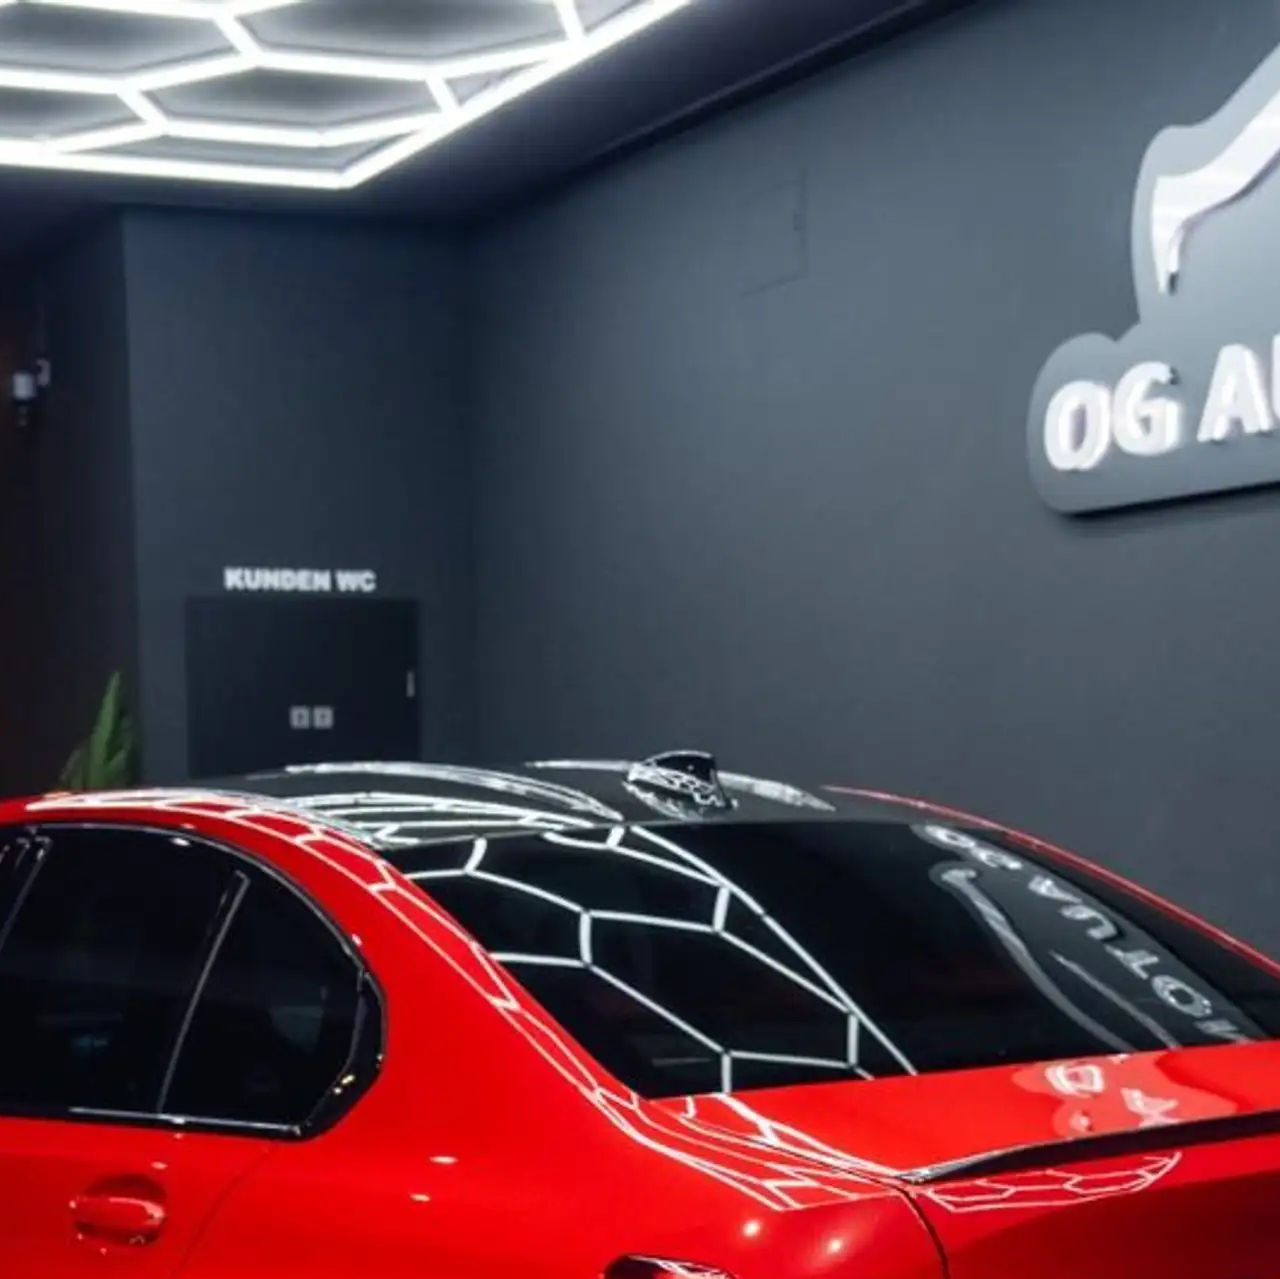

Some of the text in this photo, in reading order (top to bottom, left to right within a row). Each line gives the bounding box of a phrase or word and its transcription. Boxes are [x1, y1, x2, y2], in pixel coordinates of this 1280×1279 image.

[1043, 361, 1182, 471] OG
[224, 567, 376, 592] KUNDEN WC
